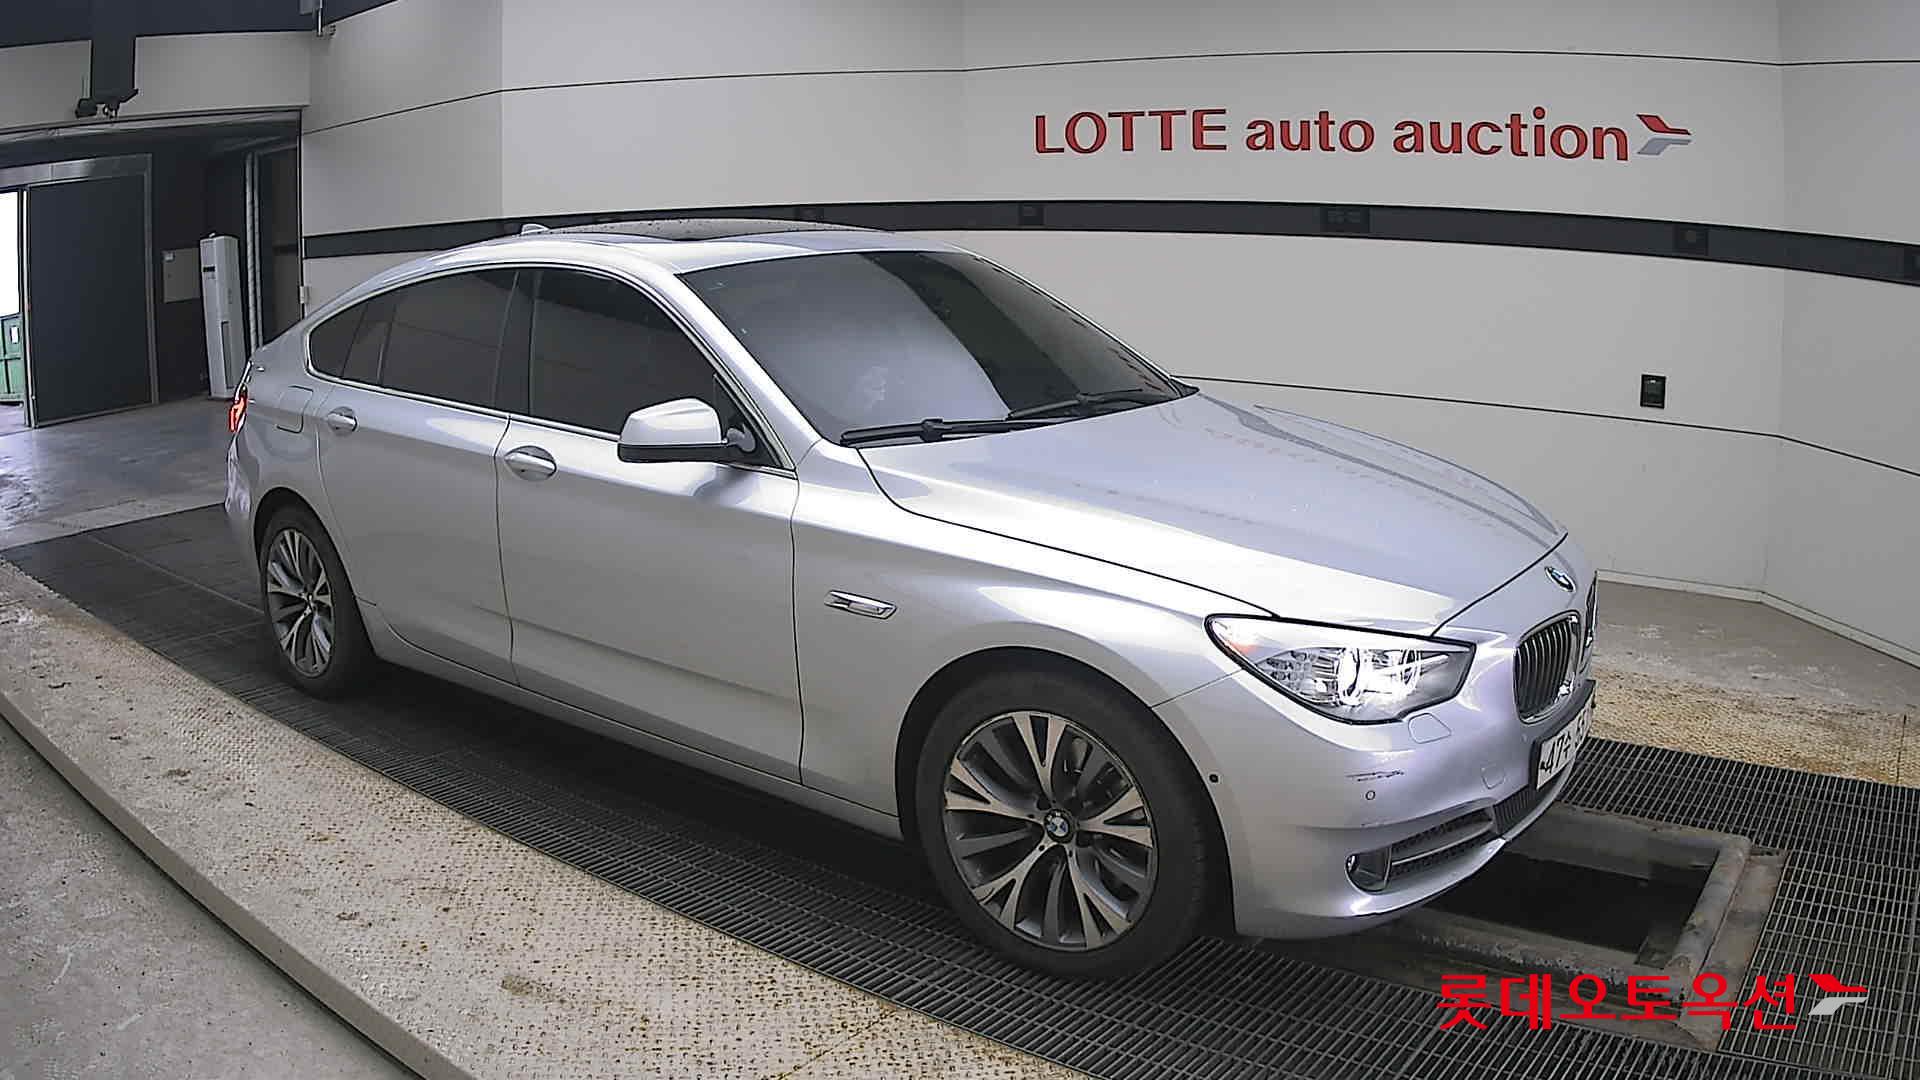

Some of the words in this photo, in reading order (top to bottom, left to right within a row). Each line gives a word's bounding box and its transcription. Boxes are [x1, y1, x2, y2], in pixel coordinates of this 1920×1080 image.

[1034, 108, 1227, 155] LOTTE
[1245, 110, 1376, 153] auto
[1392, 106, 1630, 161] auction
